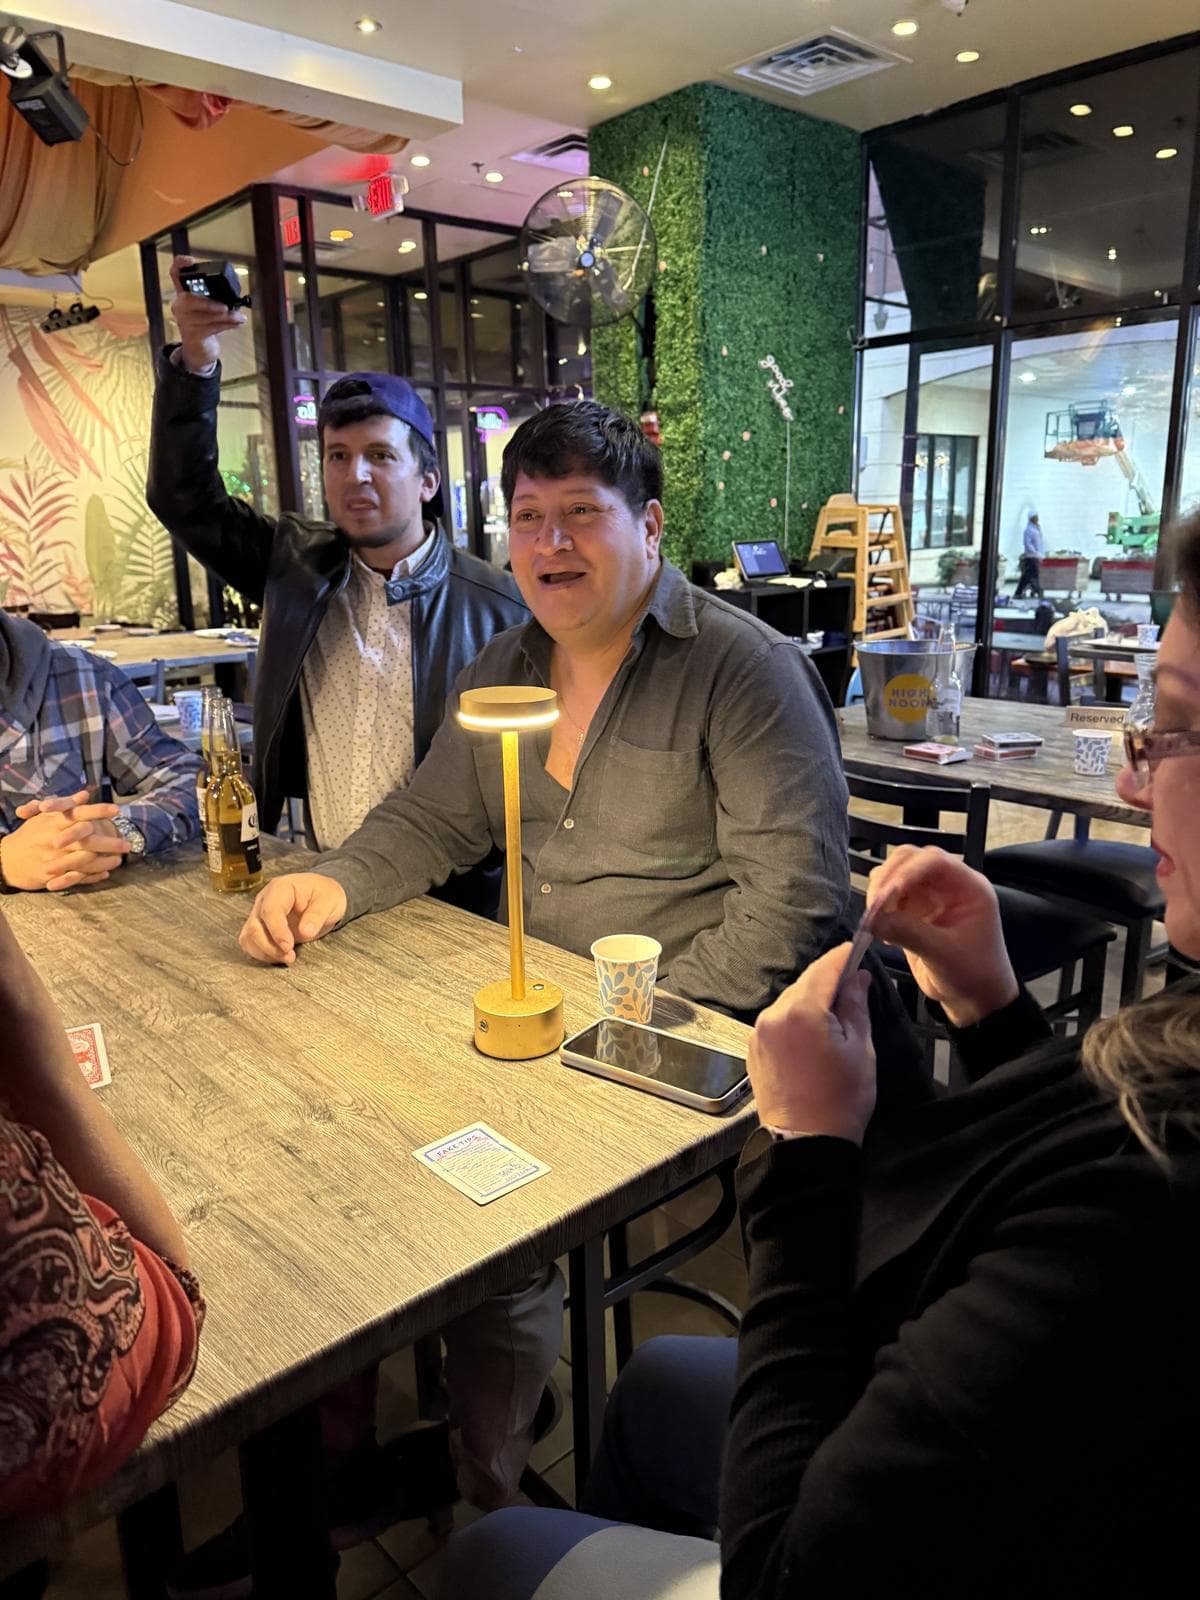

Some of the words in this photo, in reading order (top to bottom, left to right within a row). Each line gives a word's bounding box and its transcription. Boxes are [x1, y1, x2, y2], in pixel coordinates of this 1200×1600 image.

[370, 177, 392, 215] EXIT
[758, 354, 794, 388] good
[892, 687, 928, 698] HIGH
[1070, 712, 1124, 724] Reserved
[437, 1144, 459, 1157] FAKE
